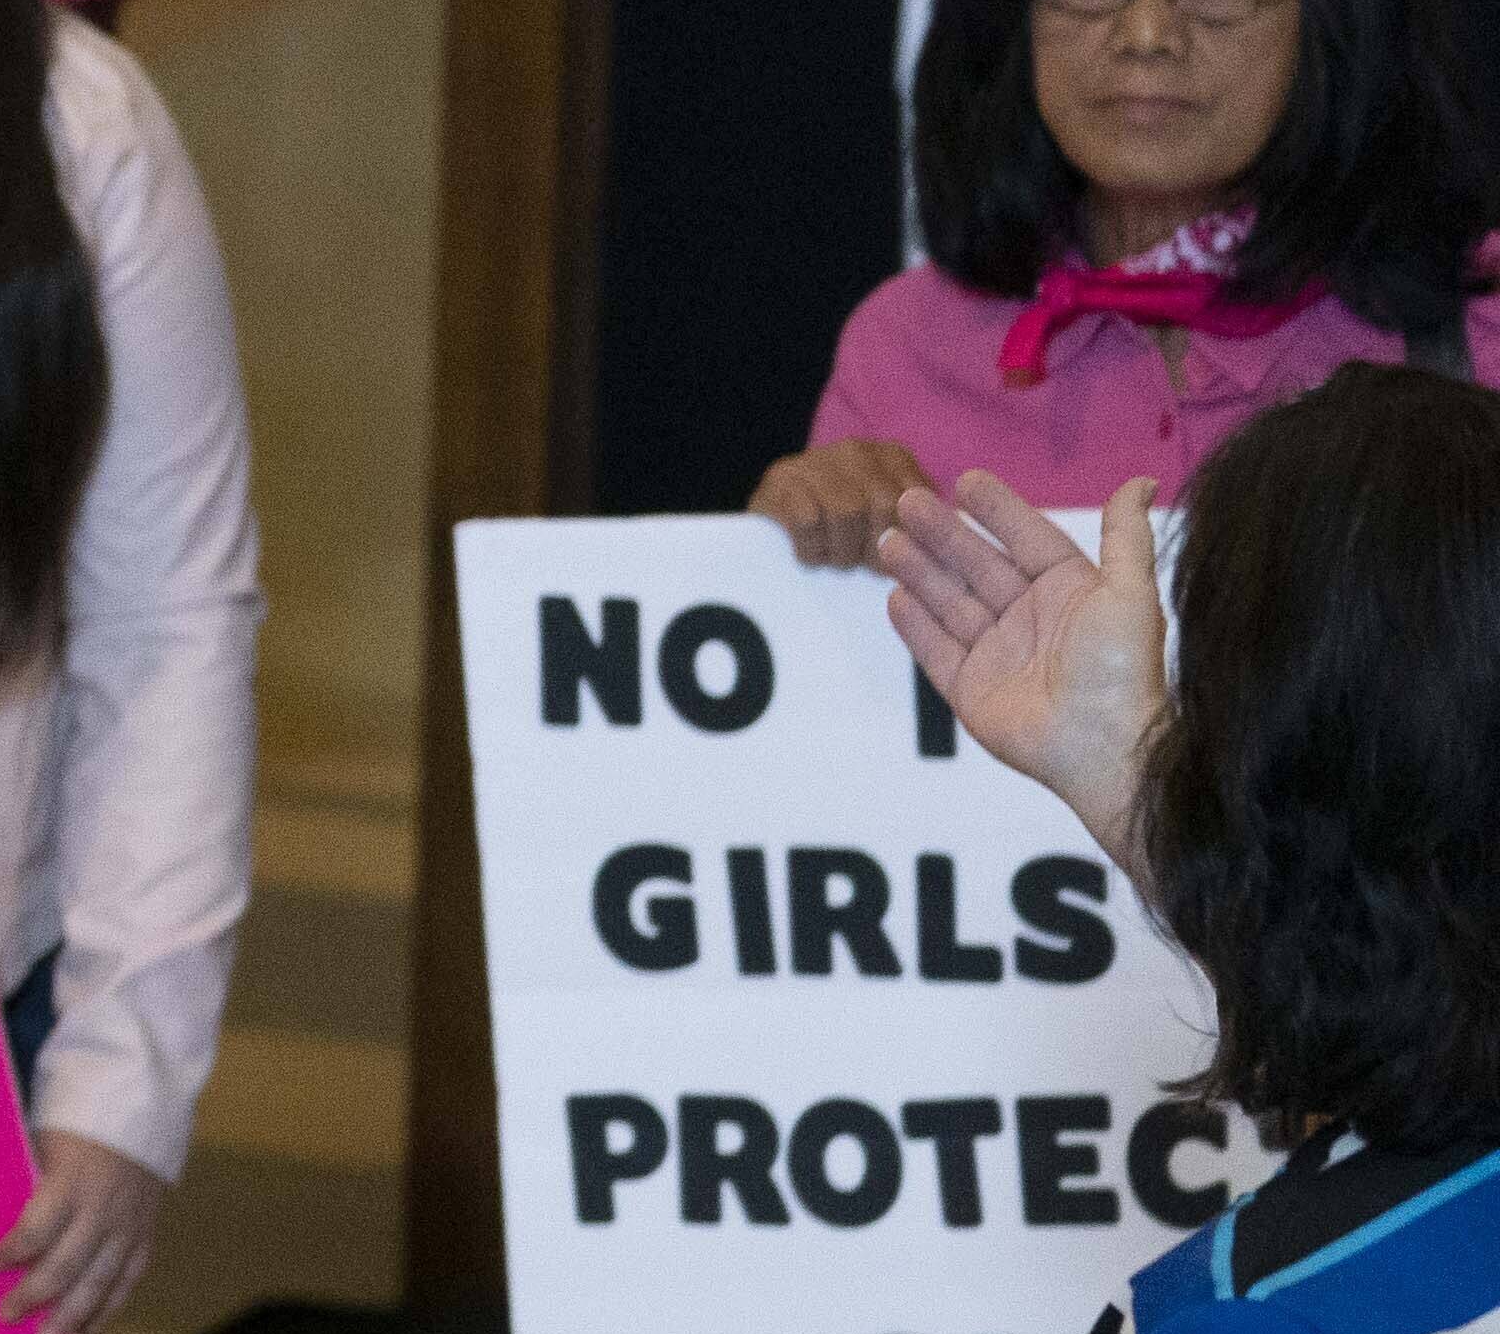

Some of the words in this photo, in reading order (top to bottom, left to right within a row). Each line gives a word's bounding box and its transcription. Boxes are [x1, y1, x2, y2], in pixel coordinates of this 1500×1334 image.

[538, 595, 776, 735] NO
[590, 841, 1117, 985] GIRLS
[564, 1092, 1233, 1230] PROTEC
